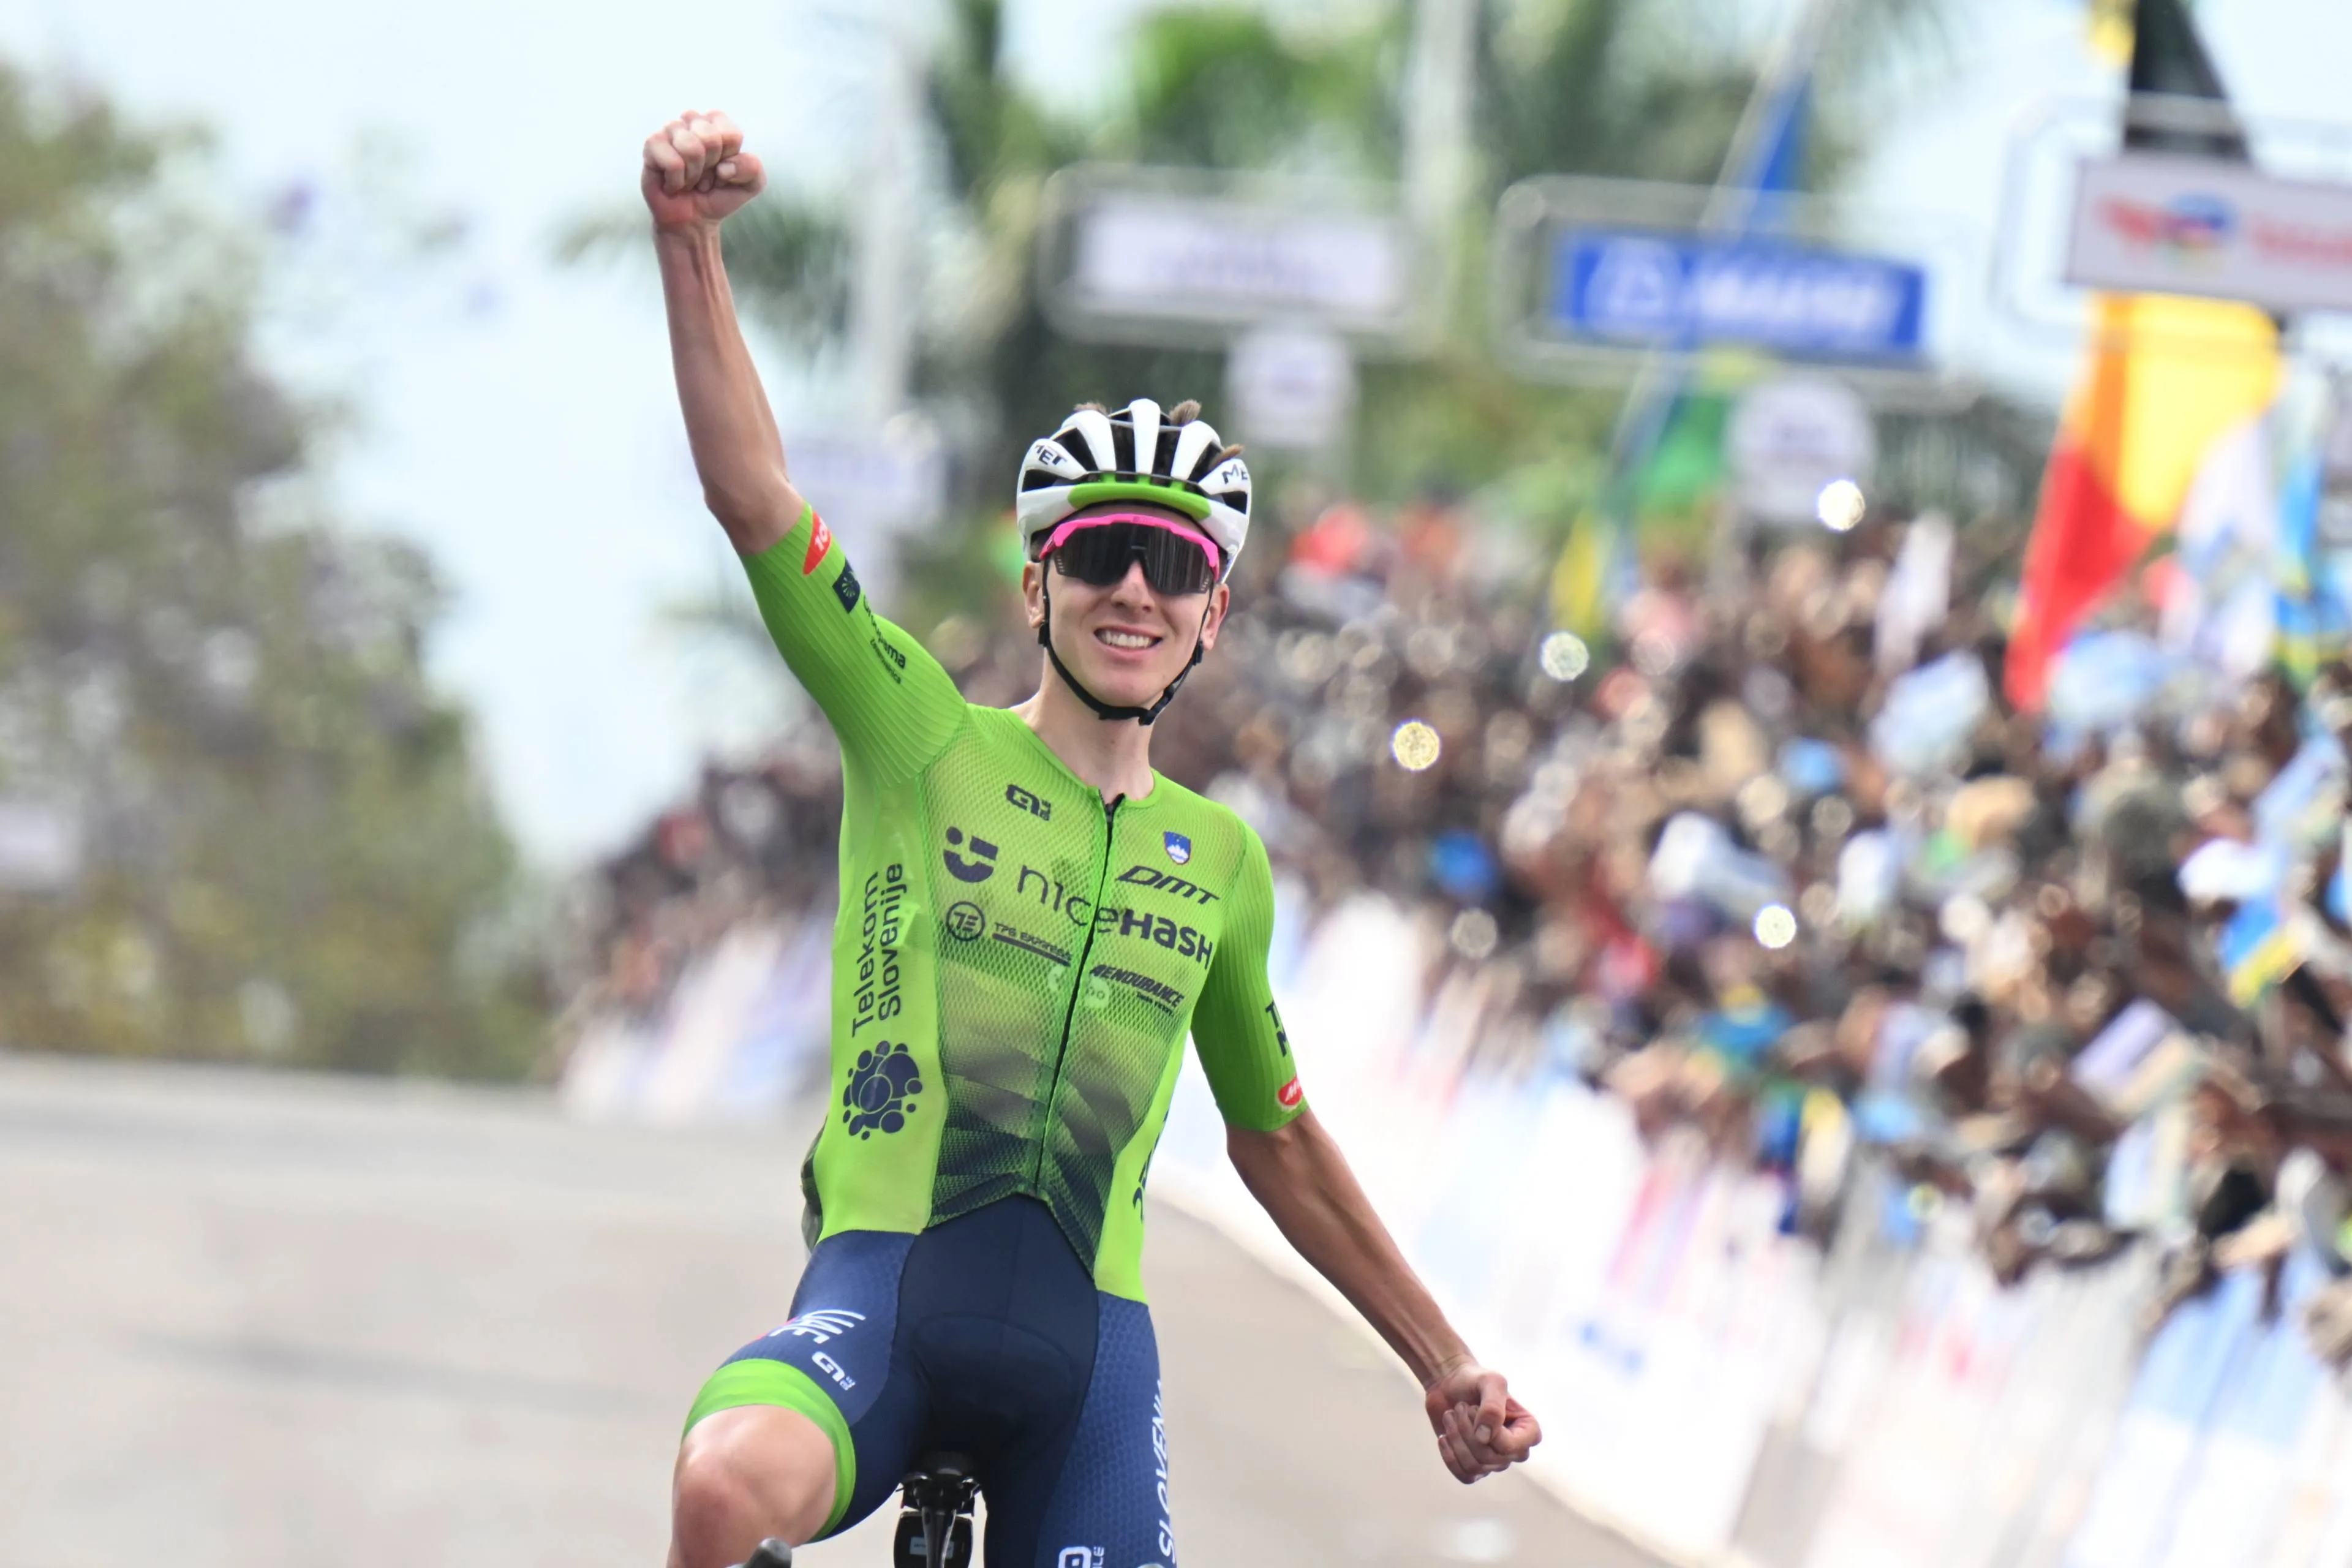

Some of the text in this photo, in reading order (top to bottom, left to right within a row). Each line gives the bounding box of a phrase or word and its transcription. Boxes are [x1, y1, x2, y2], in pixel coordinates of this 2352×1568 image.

[1222, 464, 1248, 484] ME
[852, 871, 878, 1038] Telekom
[878, 863, 907, 1021] Slovenije
